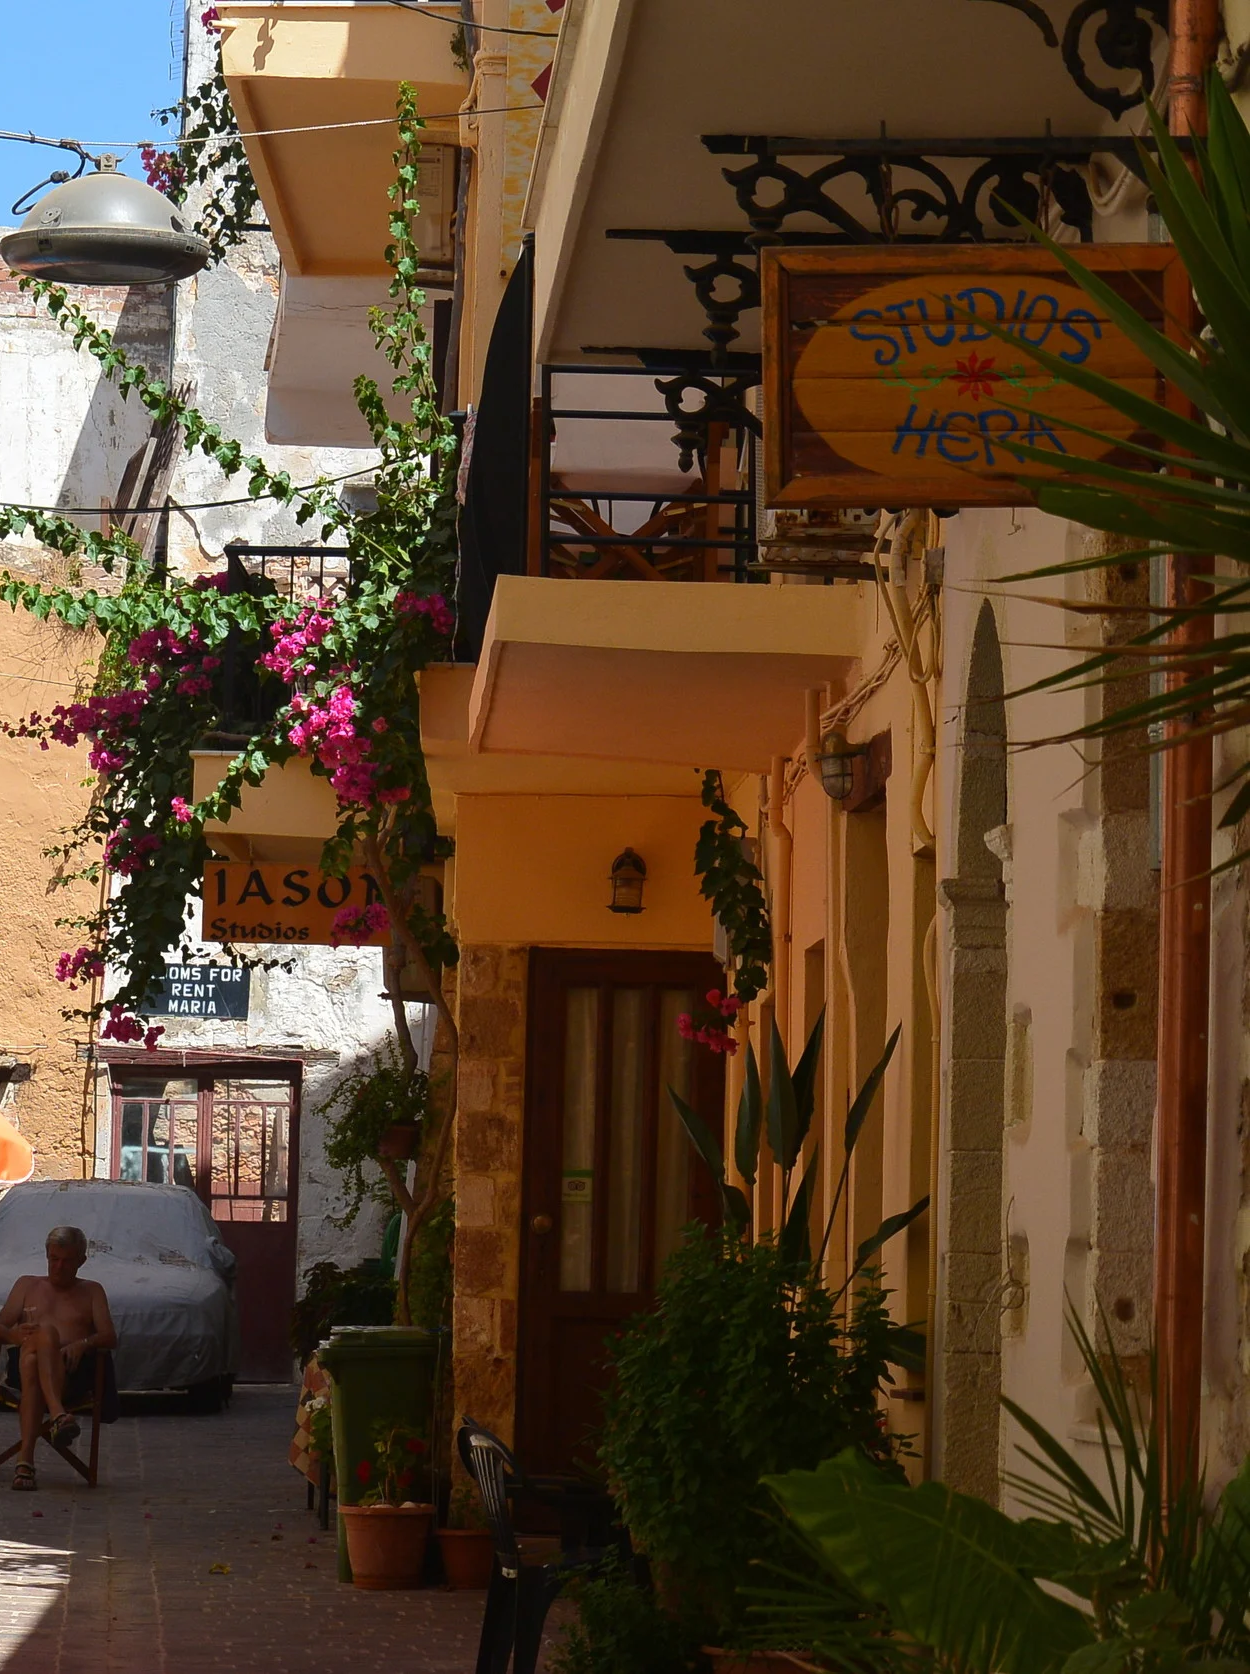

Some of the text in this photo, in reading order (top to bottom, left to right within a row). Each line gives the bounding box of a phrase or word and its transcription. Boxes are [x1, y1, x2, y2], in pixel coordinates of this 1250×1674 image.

[850, 287, 1102, 366] STUDIOS
[892, 404, 1067, 465] HERA
[210, 918, 310, 941] Studios
[154, 967, 243, 982] OMS FOR
[171, 983, 216, 998] RENT
[168, 1000, 217, 1014] MARIA
